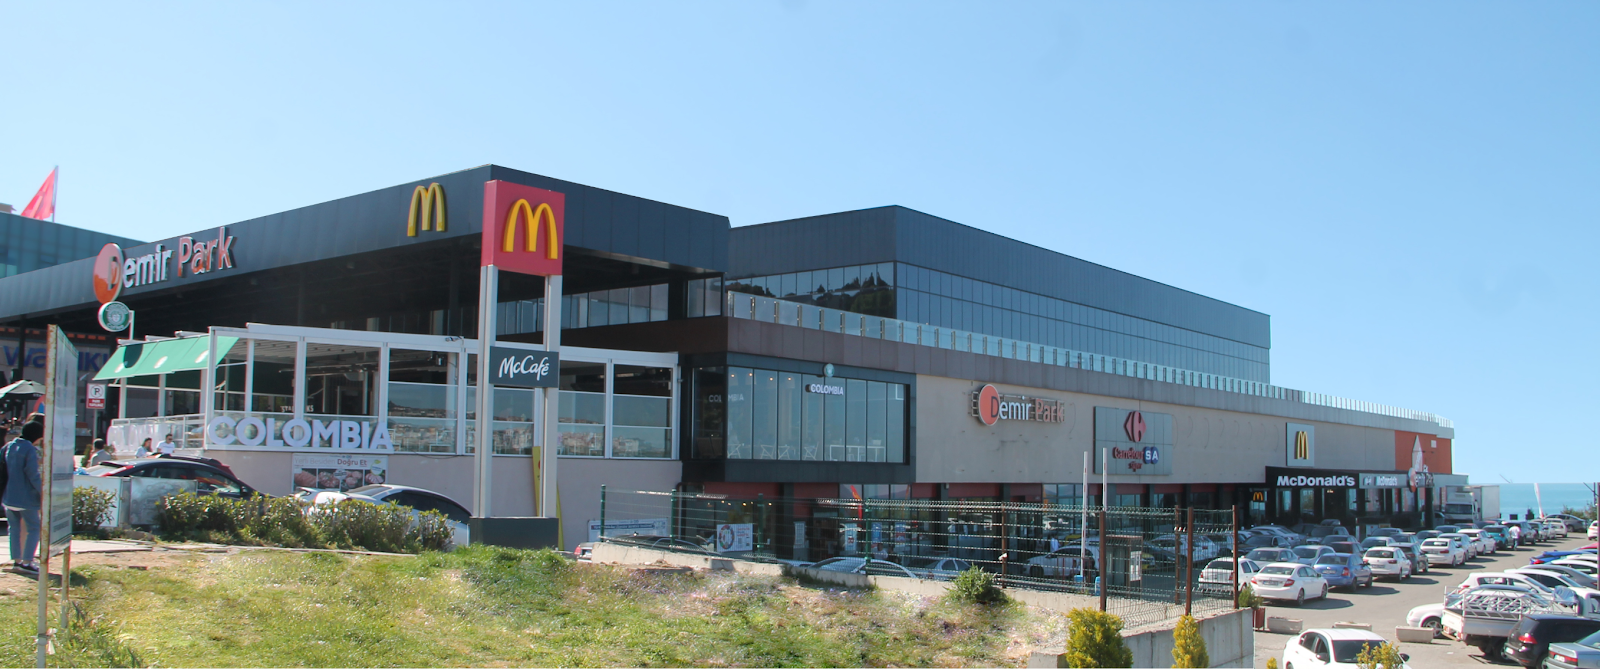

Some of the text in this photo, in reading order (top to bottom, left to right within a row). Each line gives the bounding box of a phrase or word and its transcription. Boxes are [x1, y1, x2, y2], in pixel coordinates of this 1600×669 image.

[107, 227, 234, 291] Demir Park
[498, 354, 550, 381] McCafé
[708, 393, 744, 402] COLMBIA
[810, 383, 844, 396] COLOMBIA
[989, 394, 1065, 423] Demir Park
[207, 415, 395, 450] COLOMBIA
[337, 458, 359, 467] Doğru
[1276, 475, 1356, 487] McDonald's
